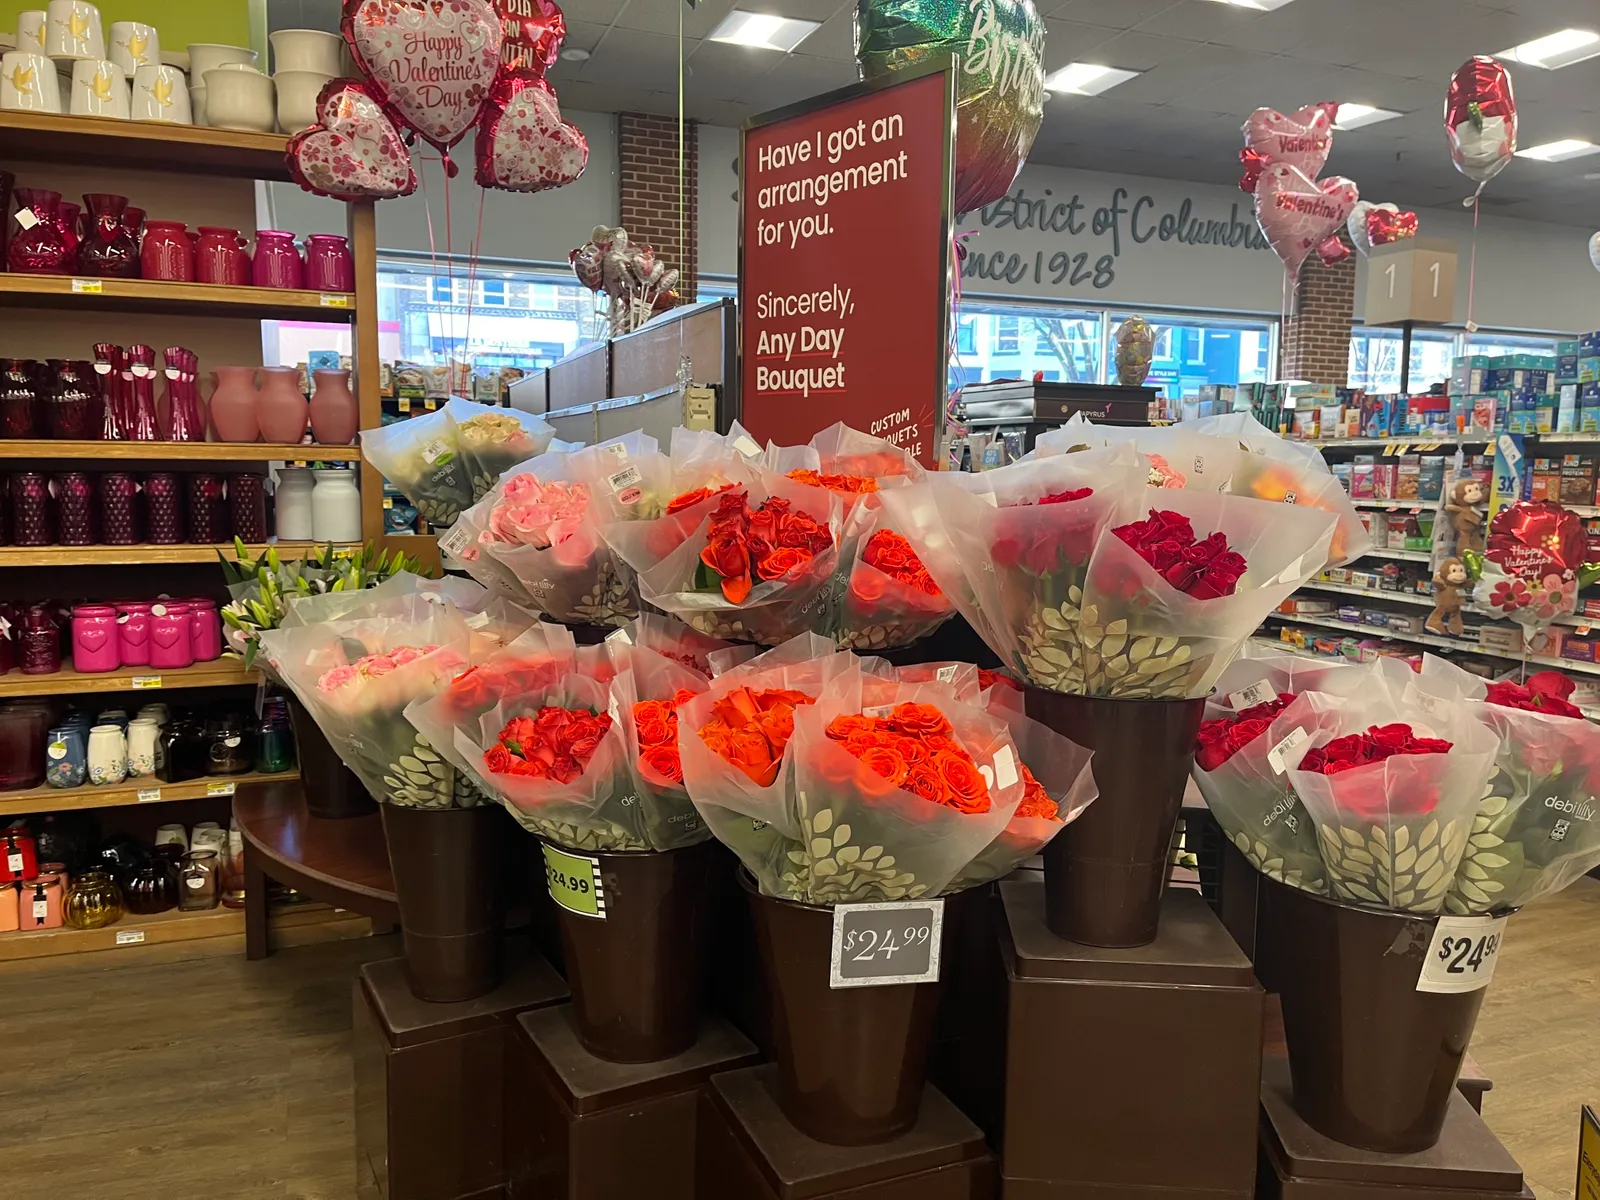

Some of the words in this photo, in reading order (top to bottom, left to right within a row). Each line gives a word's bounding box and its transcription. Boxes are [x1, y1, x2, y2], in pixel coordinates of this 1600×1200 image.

[403, 31, 464, 60] Happy
[416, 84, 464, 116] Day
[758, 140, 811, 173] Have
[816, 131, 822, 158] I
[827, 119, 866, 164] got
[871, 113, 903, 143] an
[757, 150, 908, 206] arrangement
[757, 218, 784, 246] for
[789, 213, 834, 249] you.
[1091, 187, 1128, 257] of
[1033, 250, 1115, 289] 1928
[1384, 263, 1396, 299] 1
[1429, 262, 1441, 298] 1
[756, 283, 855, 320] Sincerely,
[756, 330, 797, 362] Any
[800, 326, 845, 359] Day
[756, 362, 845, 398] Bouquet
[870, 407, 910, 435] CUSTOM
[1497, 475, 1516, 492] 3X
[1509, 544, 1543, 559] Happy
